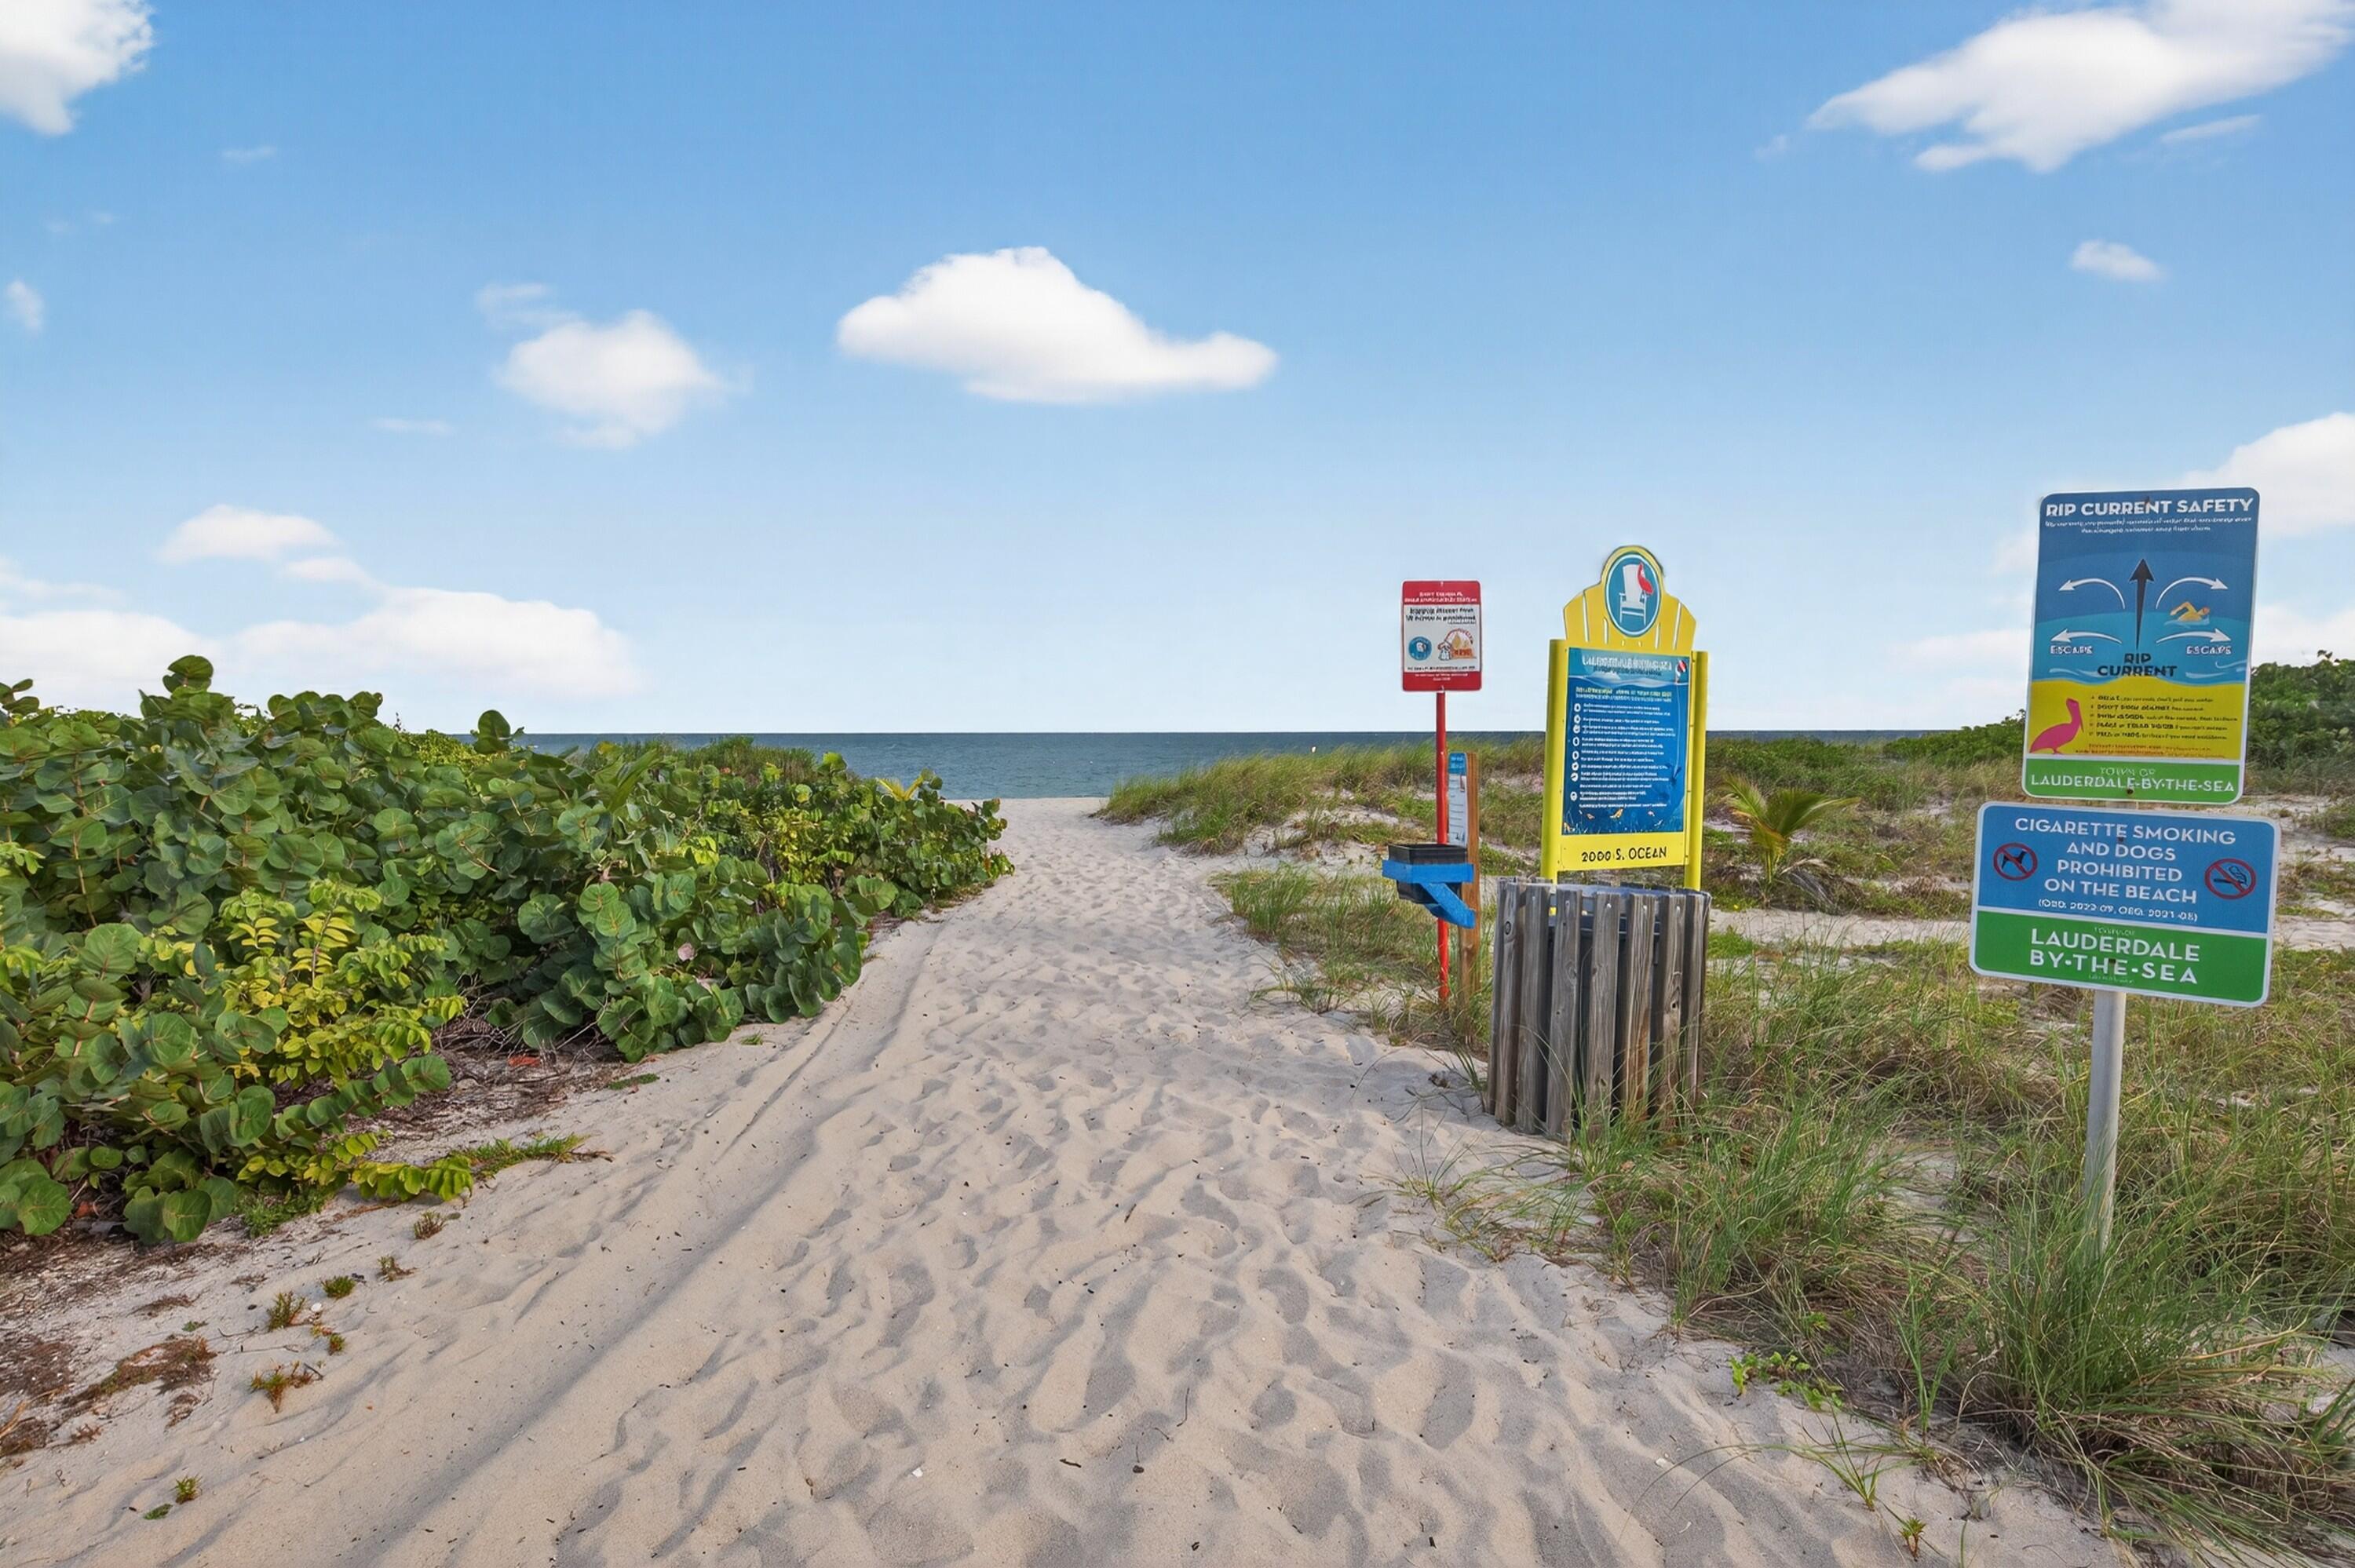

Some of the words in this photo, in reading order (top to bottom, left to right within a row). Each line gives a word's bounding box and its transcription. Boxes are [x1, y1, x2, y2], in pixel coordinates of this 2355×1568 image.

[2046, 503, 2076, 517] RIP
[2080, 500, 2172, 516] CURRENT
[2176, 498, 2254, 514] SAFETY
[2123, 653, 2152, 664] RIP
[2097, 665, 2177, 677] CURRENT
[2014, 818, 2127, 838] CIGARETTE
[2132, 825, 2236, 845] SMOKING
[1582, 851, 1612, 862] 2000
[1628, 846, 1667, 860] OCEAN
[2066, 841, 2110, 857] AND
[2115, 844, 2177, 862] DOGS
[2057, 859, 2182, 882] PROHIBITED
[2044, 878, 2075, 893] ON
[2080, 881, 2120, 897] THE
[2125, 884, 2197, 904] BEACH
[2031, 928, 2200, 961] LAUDERDALE
